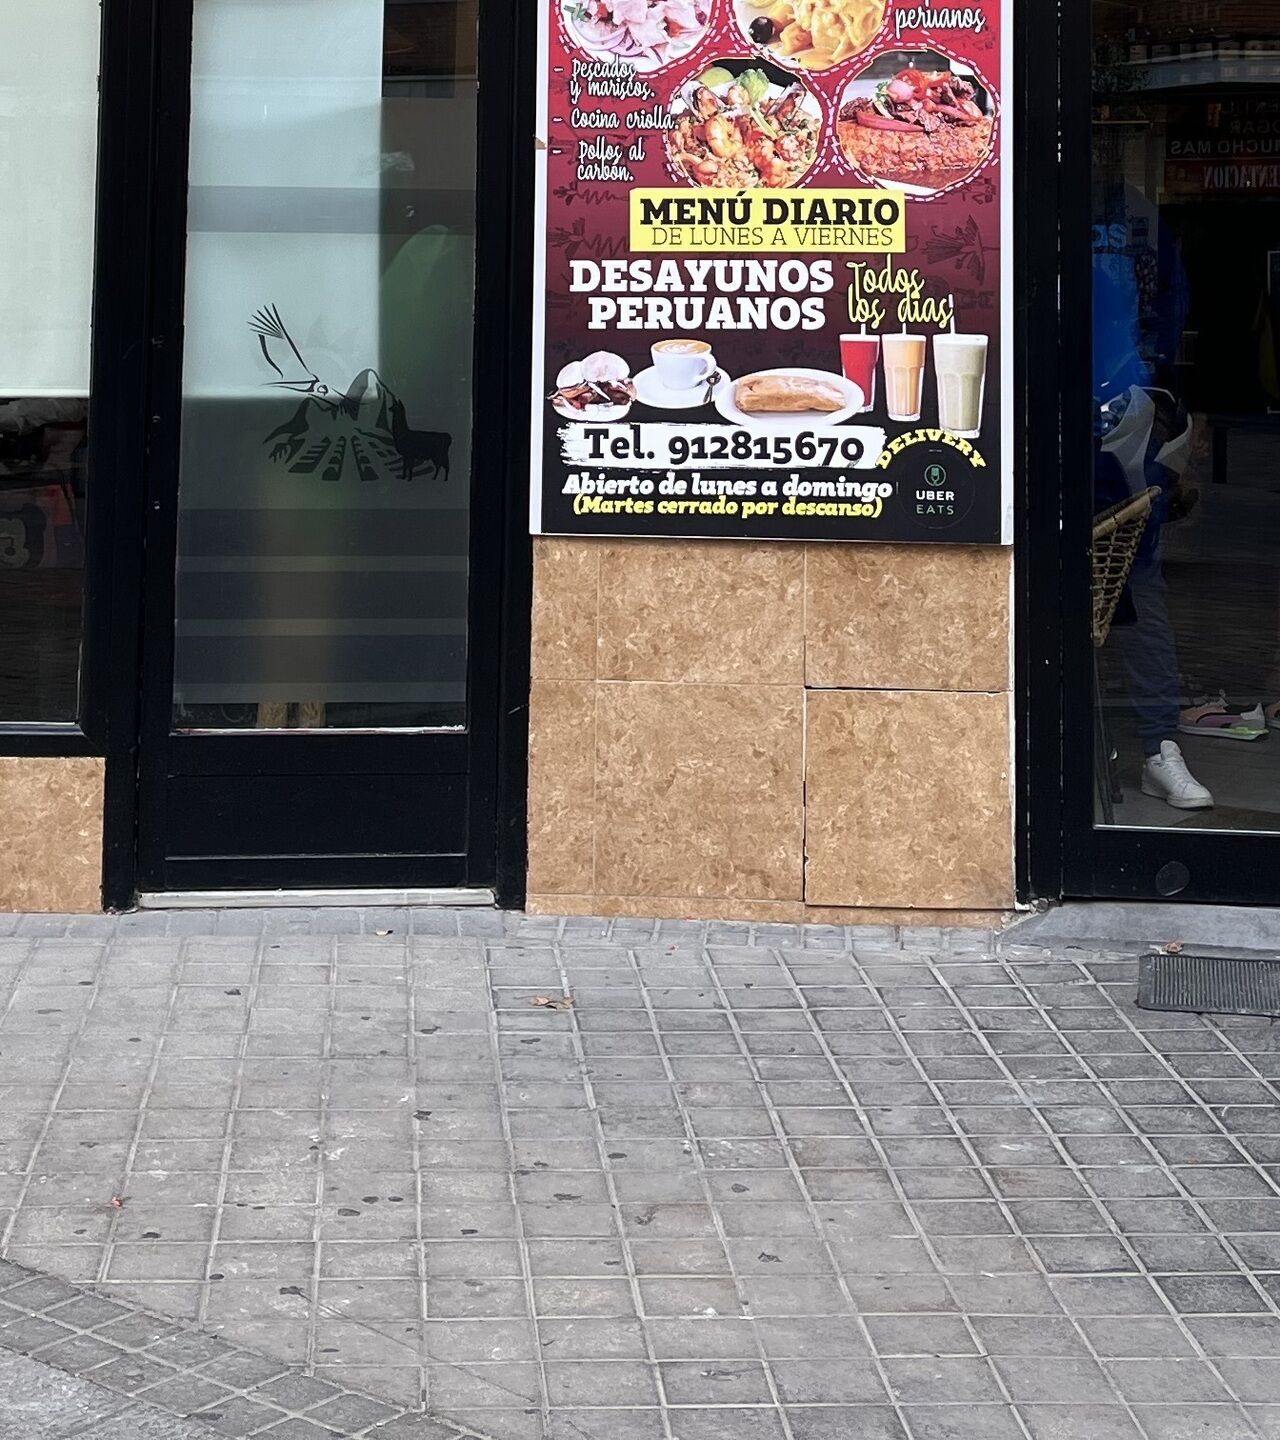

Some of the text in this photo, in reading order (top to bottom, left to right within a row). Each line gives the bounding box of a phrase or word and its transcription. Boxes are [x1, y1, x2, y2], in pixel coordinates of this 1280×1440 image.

[895, 6, 986, 40] peruanos
[570, 78, 656, 104] y mariscos.
[571, 105, 680, 130] Cocina criolla.
[629, 137, 645, 161] al
[639, 191, 901, 226] MENÚ DIARIO
[651, 227, 893, 246] DE LUNES A VIERNES
[569, 253, 925, 301] DESAYUNOS Todos
[588, 296, 826, 330] PERUANOS
[848, 283, 886, 329] los
[584, 428, 864, 468] Tel. 912815670
[875, 428, 986, 469] DELIVERY
[561, 473, 893, 502] Abierto de lunes a domingo
[915, 490, 955, 501] UBER
[572, 495, 883, 519] (Martes cerrado por descanso)
[916, 504, 954, 515] EATS
